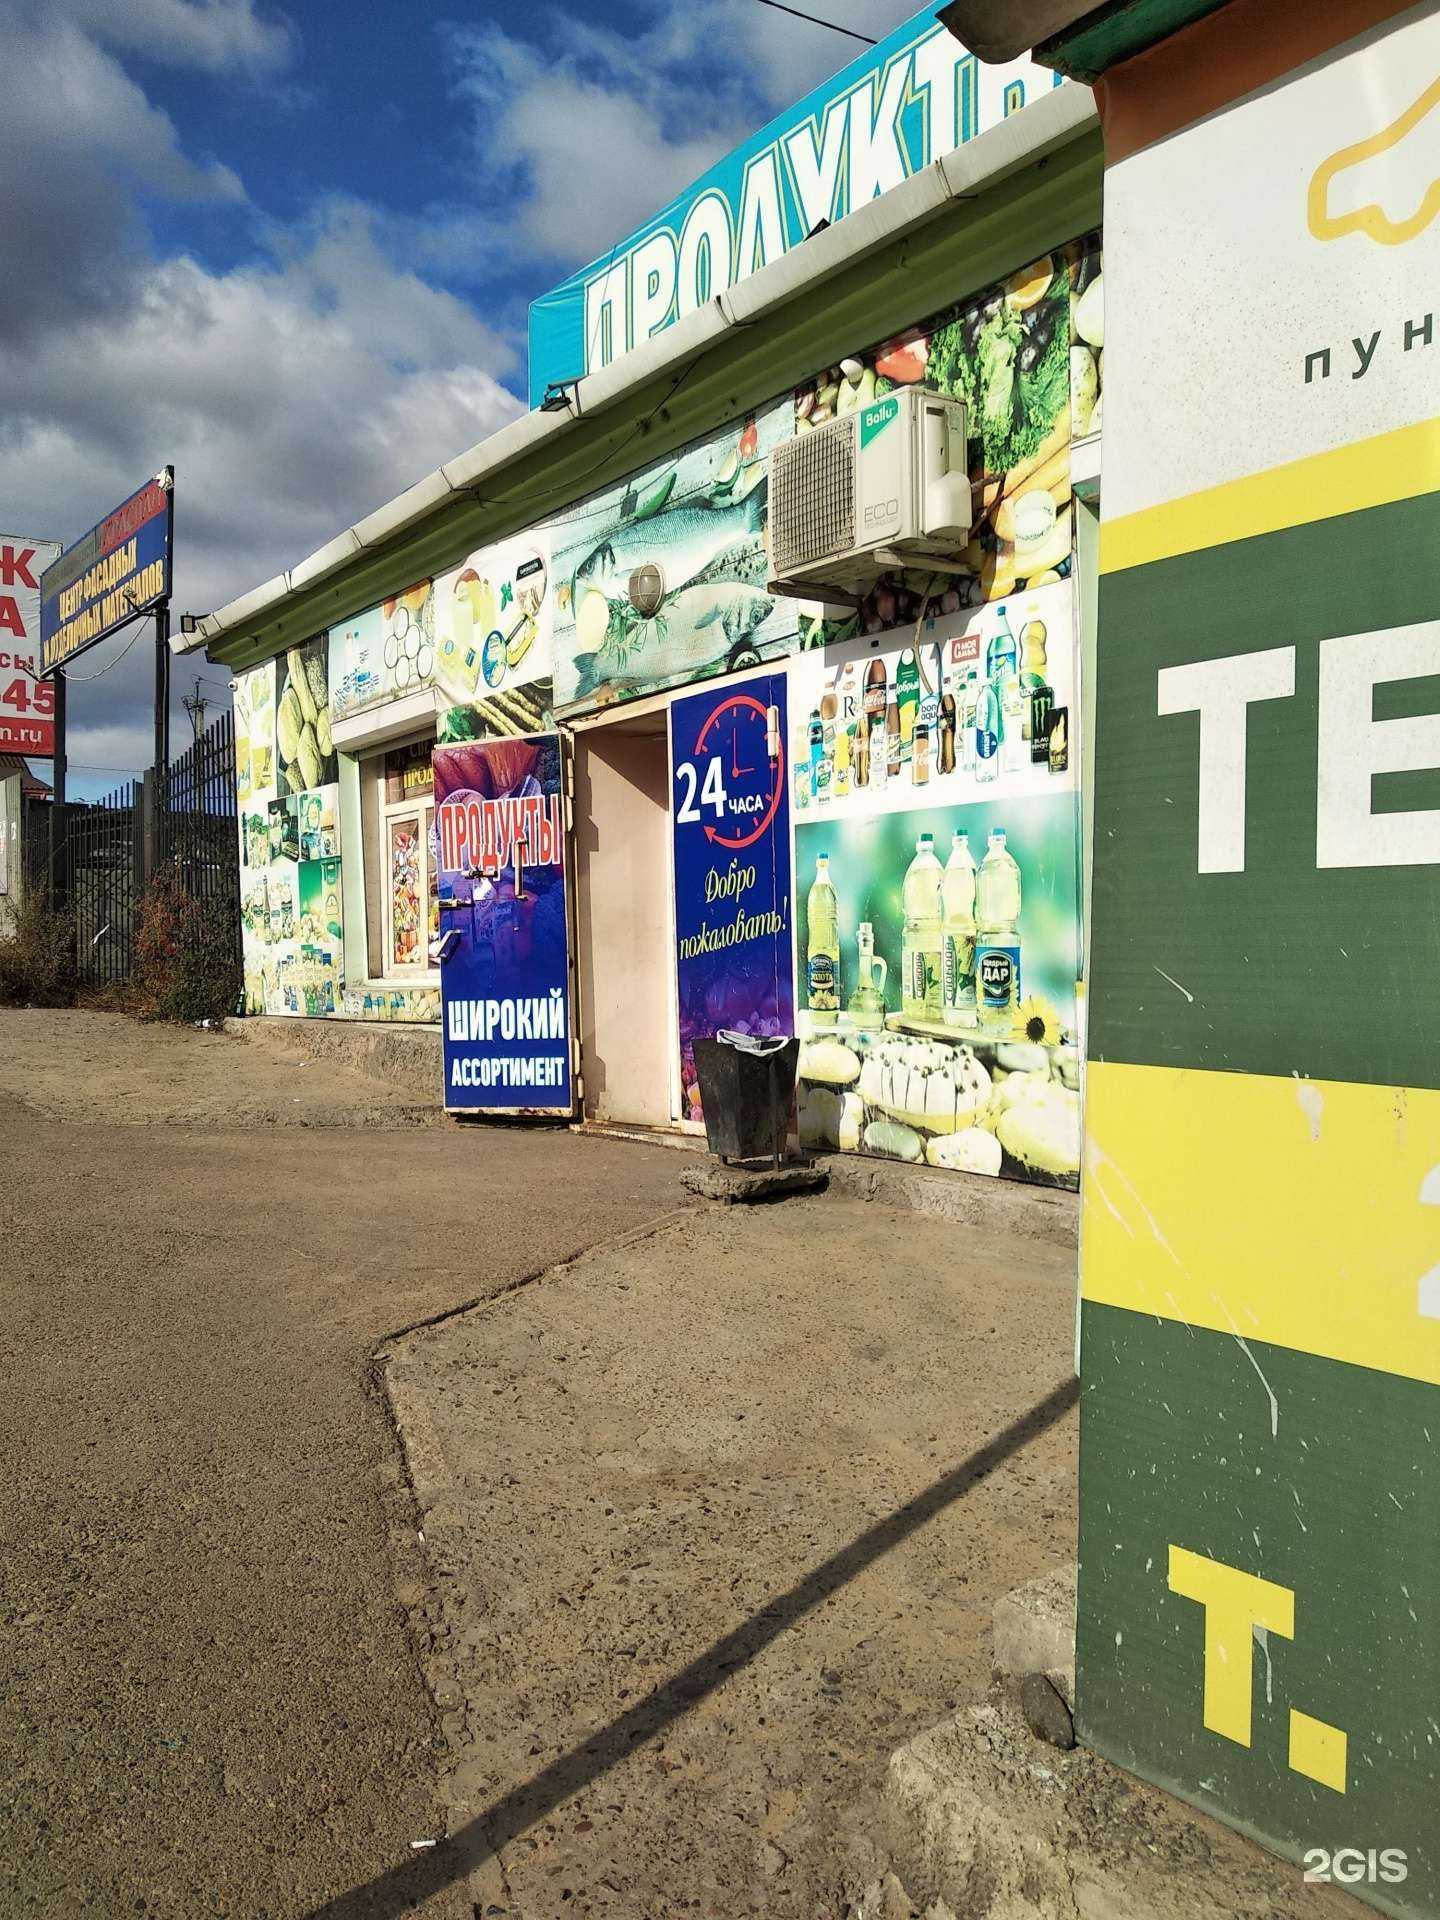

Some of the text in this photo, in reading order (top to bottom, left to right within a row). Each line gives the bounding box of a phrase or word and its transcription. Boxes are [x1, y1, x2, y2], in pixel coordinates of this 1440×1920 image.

[864, 499, 899, 522] ECO
[59, 578, 83, 623] ЦЕНТР
[676, 756, 728, 824] 24
[438, 794, 560, 881] ПРОДУКТЫ
[705, 857, 756, 904] Добро
[679, 895, 788, 962] пожаловать!
[983, 967, 1009, 982] ДАР
[448, 988, 565, 1042] ШИРОКИЙ
[452, 1056, 565, 1087] АССОРТИМЕНТ
